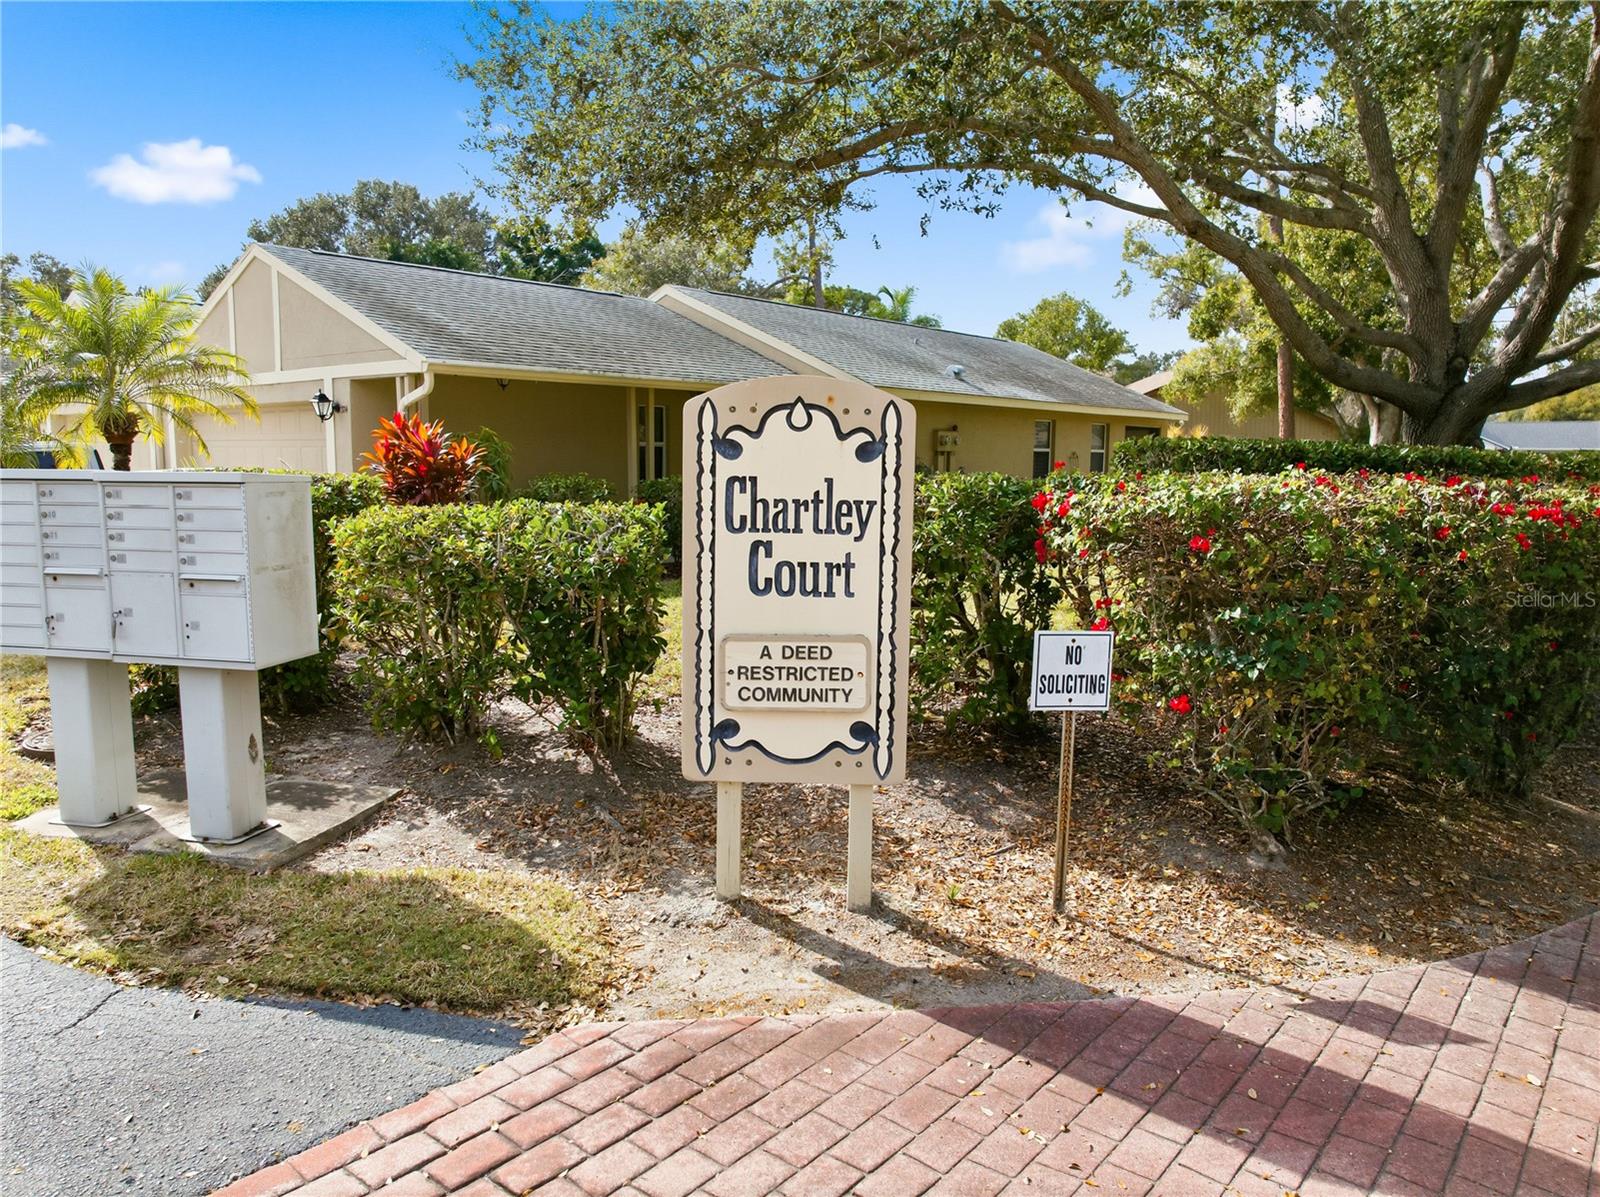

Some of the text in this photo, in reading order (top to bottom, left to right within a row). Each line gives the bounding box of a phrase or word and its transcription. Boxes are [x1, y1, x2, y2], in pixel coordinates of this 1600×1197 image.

[724, 475, 877, 542] Chartley
[748, 539, 856, 598] Court
[759, 645, 833, 660] A DEED
[1065, 645, 1082, 665] NO
[737, 666, 854, 682] RESTRICTED
[738, 686, 853, 703] COMMUNITY
[1039, 674, 1106, 695] SOLICITING
